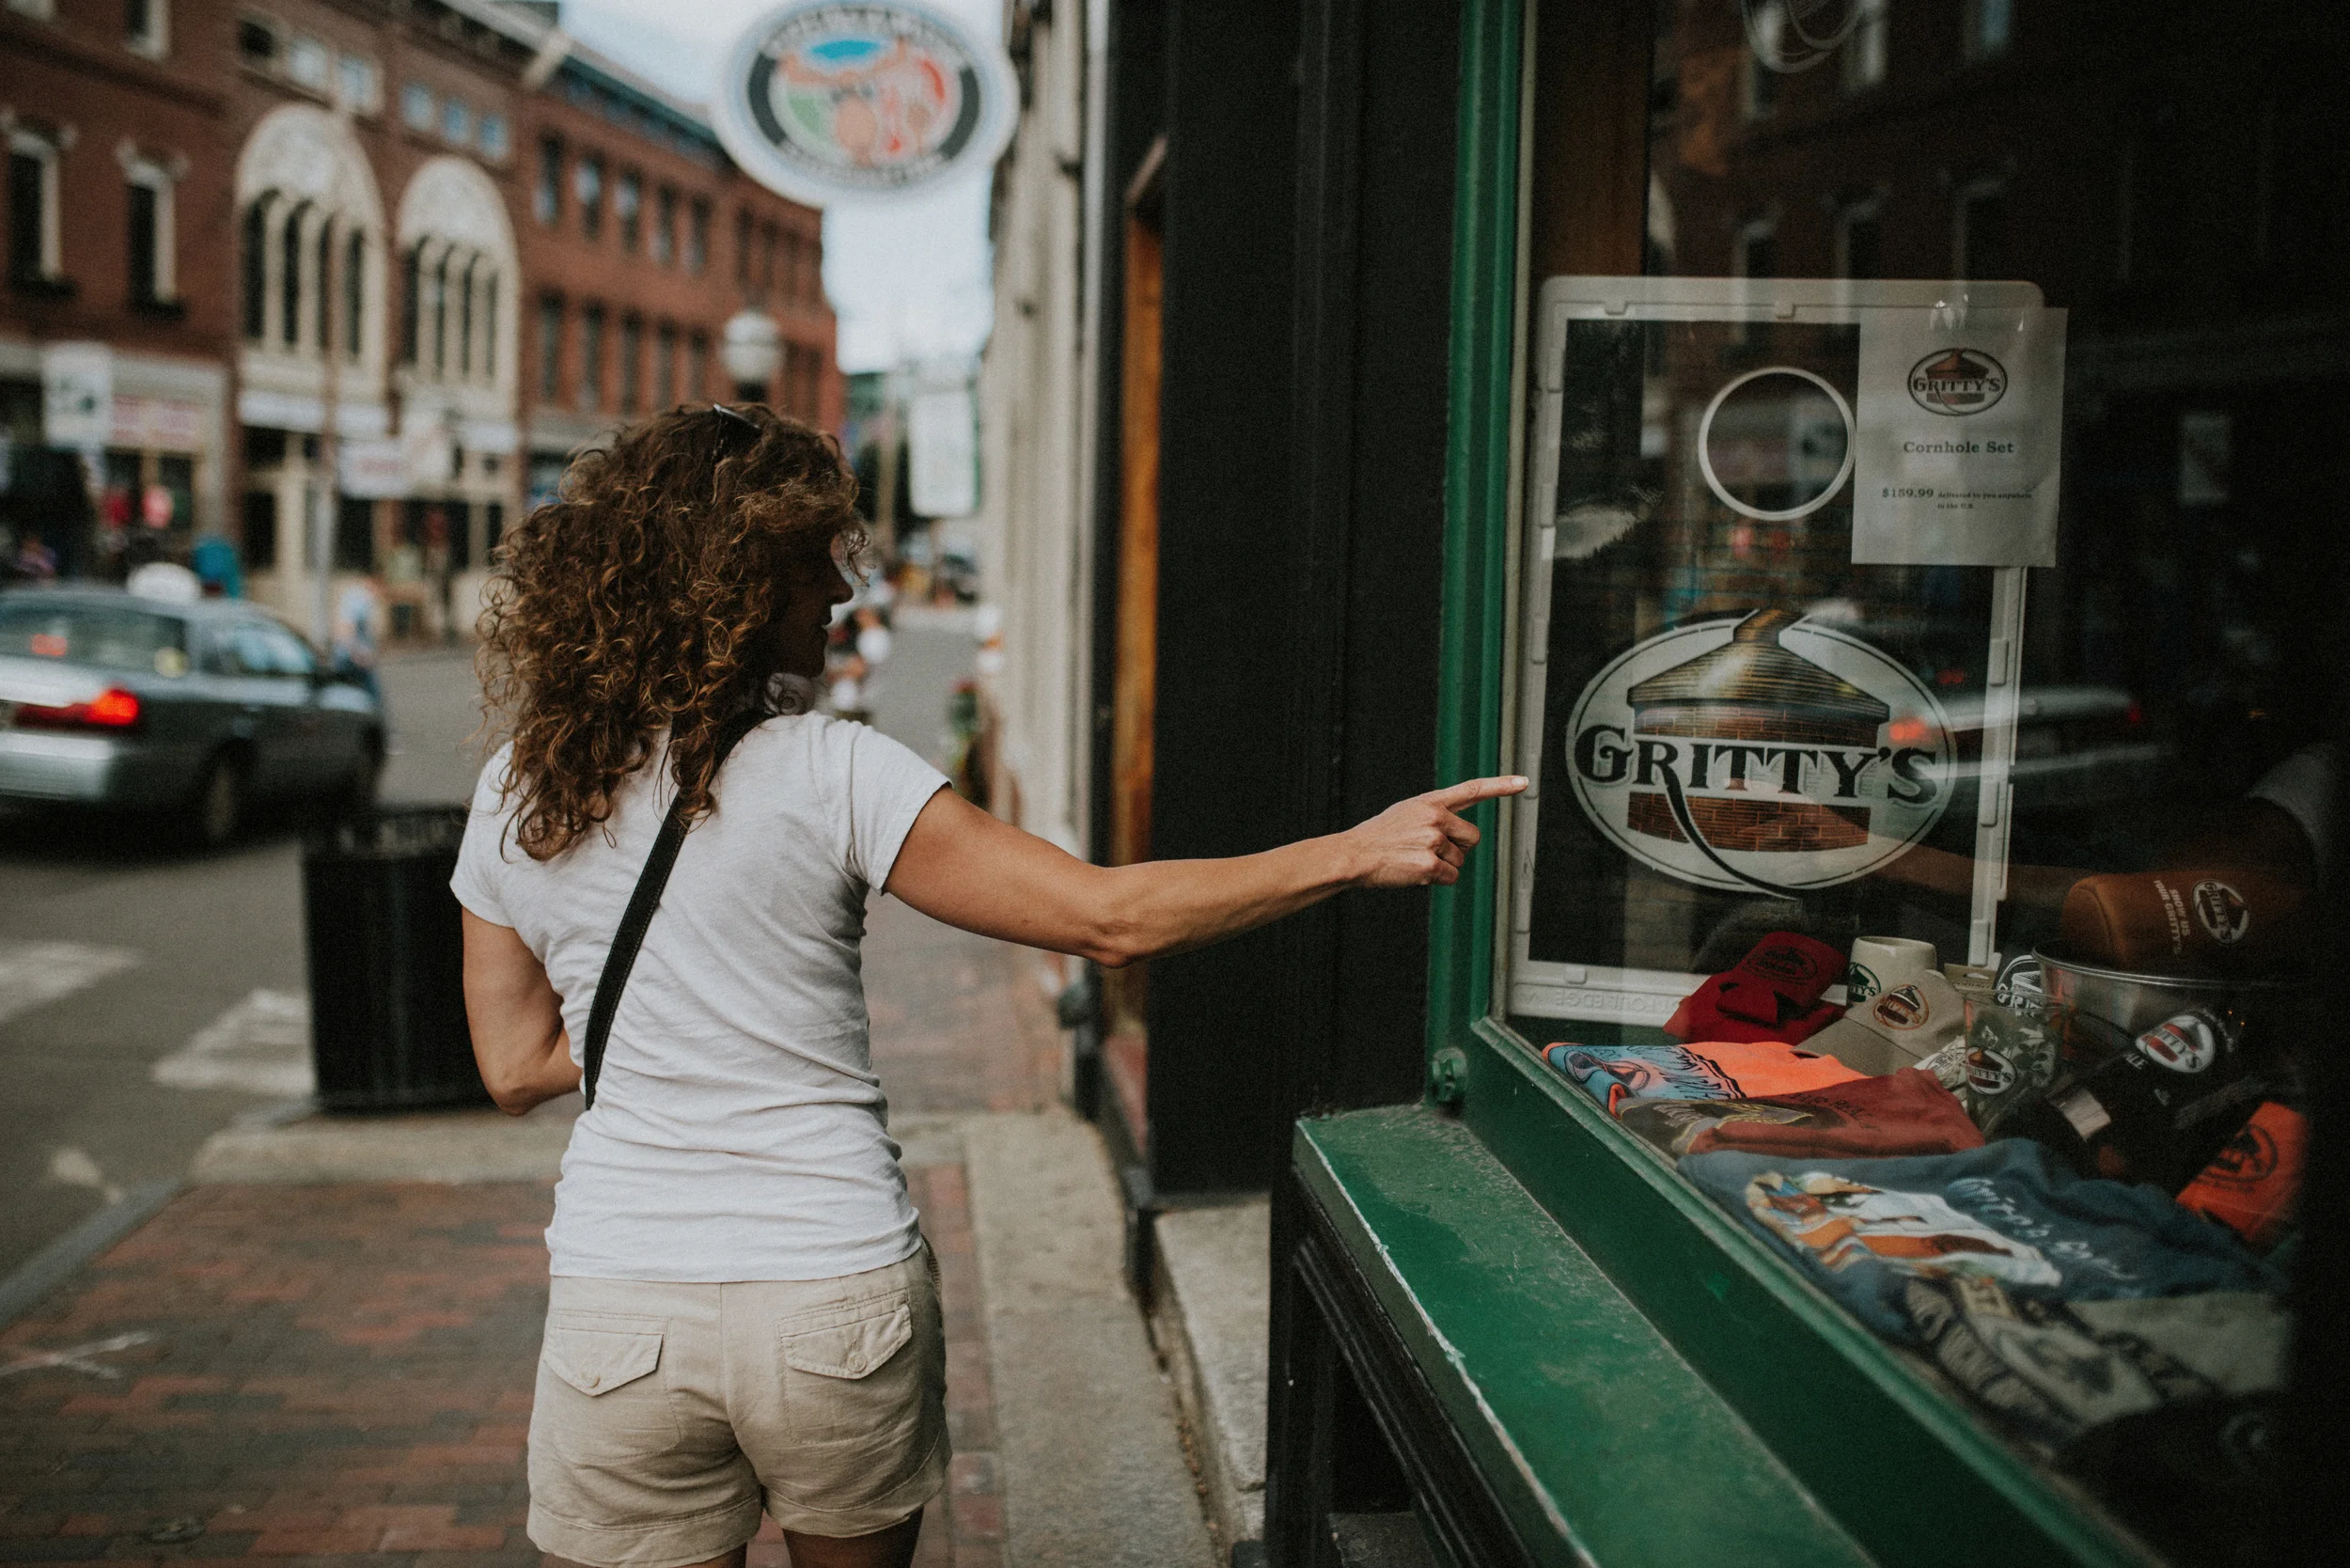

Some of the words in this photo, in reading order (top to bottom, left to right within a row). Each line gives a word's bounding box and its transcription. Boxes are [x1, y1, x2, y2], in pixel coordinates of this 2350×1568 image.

[1913, 377, 2000, 393] GRITTY'S
[1904, 441, 1980, 453] Cornhole
[1986, 441, 2014, 453] Set
[1882, 488, 1935, 498] $159.99
[1574, 724, 1936, 805] GRITTY'S
[2170, 889, 2186, 917] SHOW
[2180, 920, 2190, 936] US
